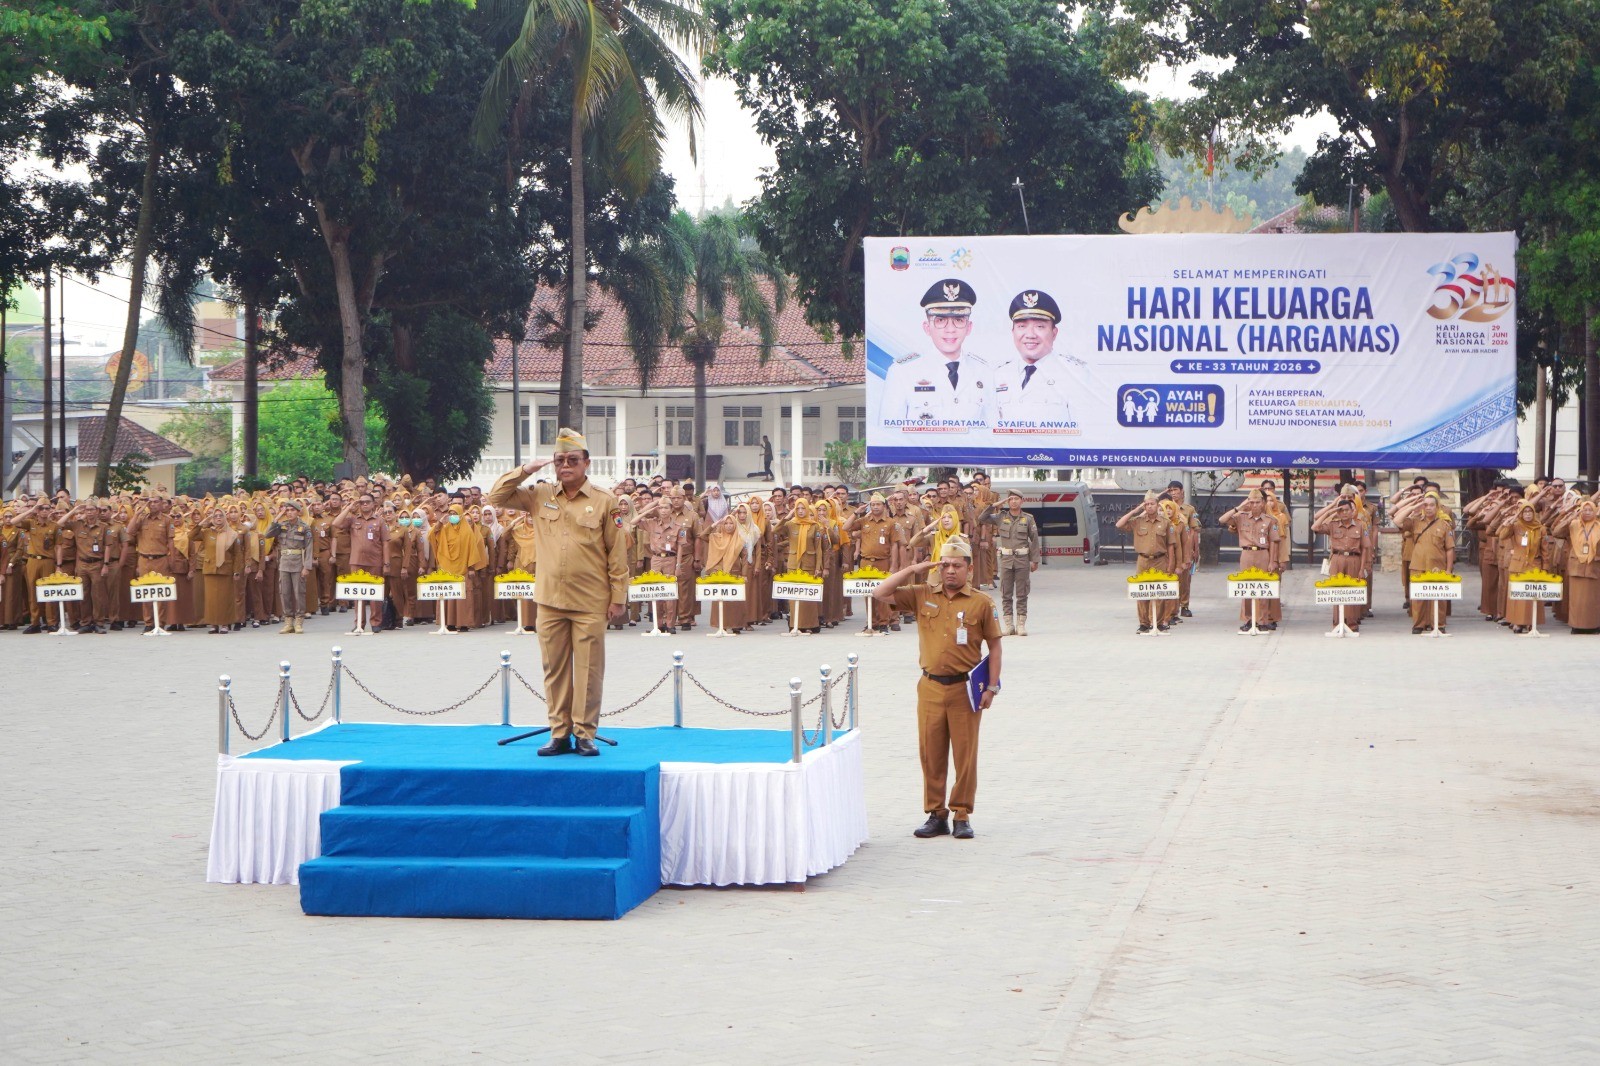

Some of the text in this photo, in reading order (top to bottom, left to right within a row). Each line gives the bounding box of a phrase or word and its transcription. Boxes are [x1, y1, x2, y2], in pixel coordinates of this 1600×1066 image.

[1173, 270, 1327, 279] SELAMAT MEMPERINGATI
[1127, 286, 1374, 320] HARI KELUARGA
[1097, 323, 1400, 355] NASIONAL (HARGANAS)
[1231, 363, 1269, 371] TAHUN
[1273, 363, 1302, 371] 2026
[1168, 390, 1203, 401] AYAH
[1249, 389, 1325, 398] AYAH BERPERAN,
[1166, 402, 1206, 412] WAJIB
[1249, 399, 1361, 408] KELUARGA BERKUALITAS,
[1166, 413, 1206, 423] HADIR
[1248, 409, 1366, 418] LAMPUNG SELATAN MAJU,
[1249, 418, 1392, 427] MENUJU INDONESIA EMAS 2045!
[1102, 455, 1176, 463] PENGENDALIAN
[1179, 455, 1233, 463] PENDUDUK
[1237, 456, 1256, 464] DAN
[1260, 456, 1273, 464] KB
[43, 587, 77, 598] BPKAD
[135, 586, 172, 600] BPPRD
[344, 587, 376, 597] RSUD
[703, 587, 738, 597] DPMD
[777, 586, 819, 596] DPMPPTSP
